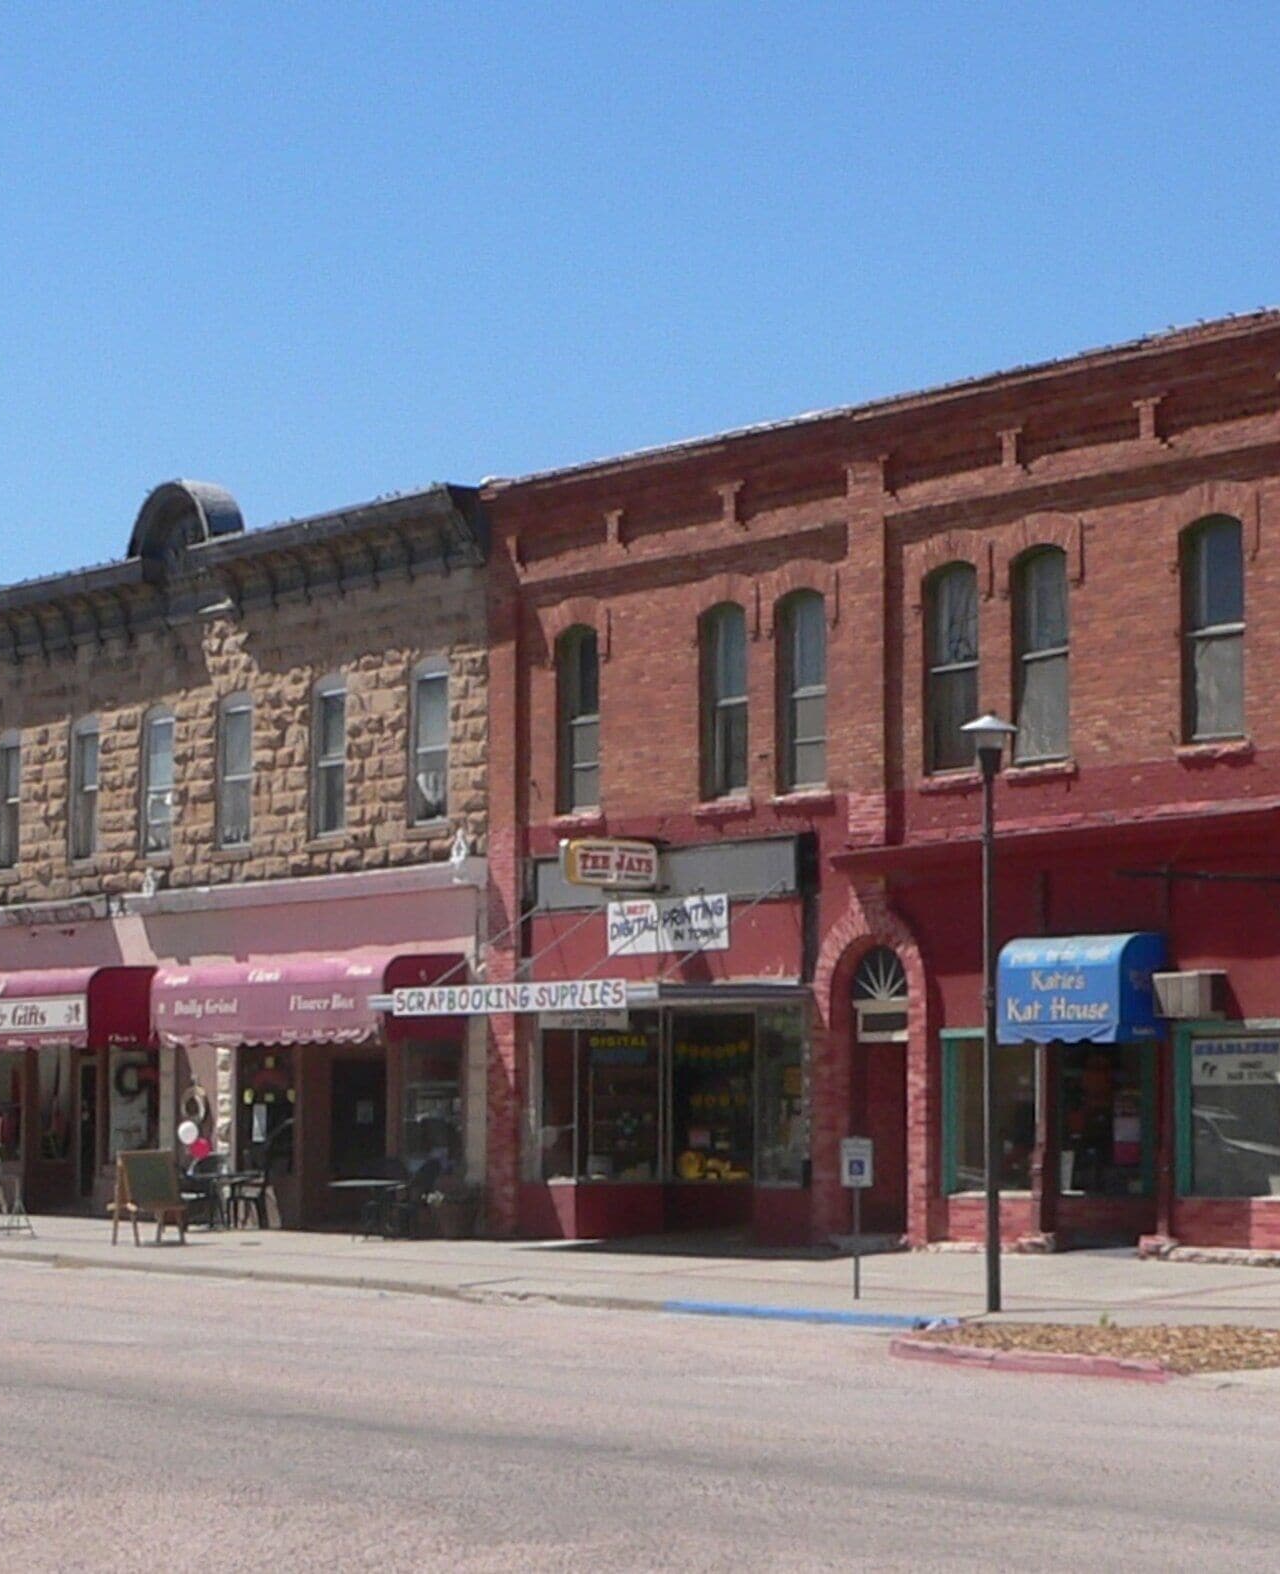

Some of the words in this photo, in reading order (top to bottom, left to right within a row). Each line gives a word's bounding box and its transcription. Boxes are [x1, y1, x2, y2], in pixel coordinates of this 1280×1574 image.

[578, 852, 611, 871] TEE
[614, 853, 654, 873] JAYS
[609, 916, 658, 941] DIGITAL
[662, 897, 725, 928] PRINTING
[394, 986, 530, 1013] SCRAPBOOKING
[534, 980, 625, 1009] SUPPLIES
[1006, 997, 1043, 1022] Kat
[1048, 995, 1110, 1021] House
[10, 1003, 48, 1027] Gifts
